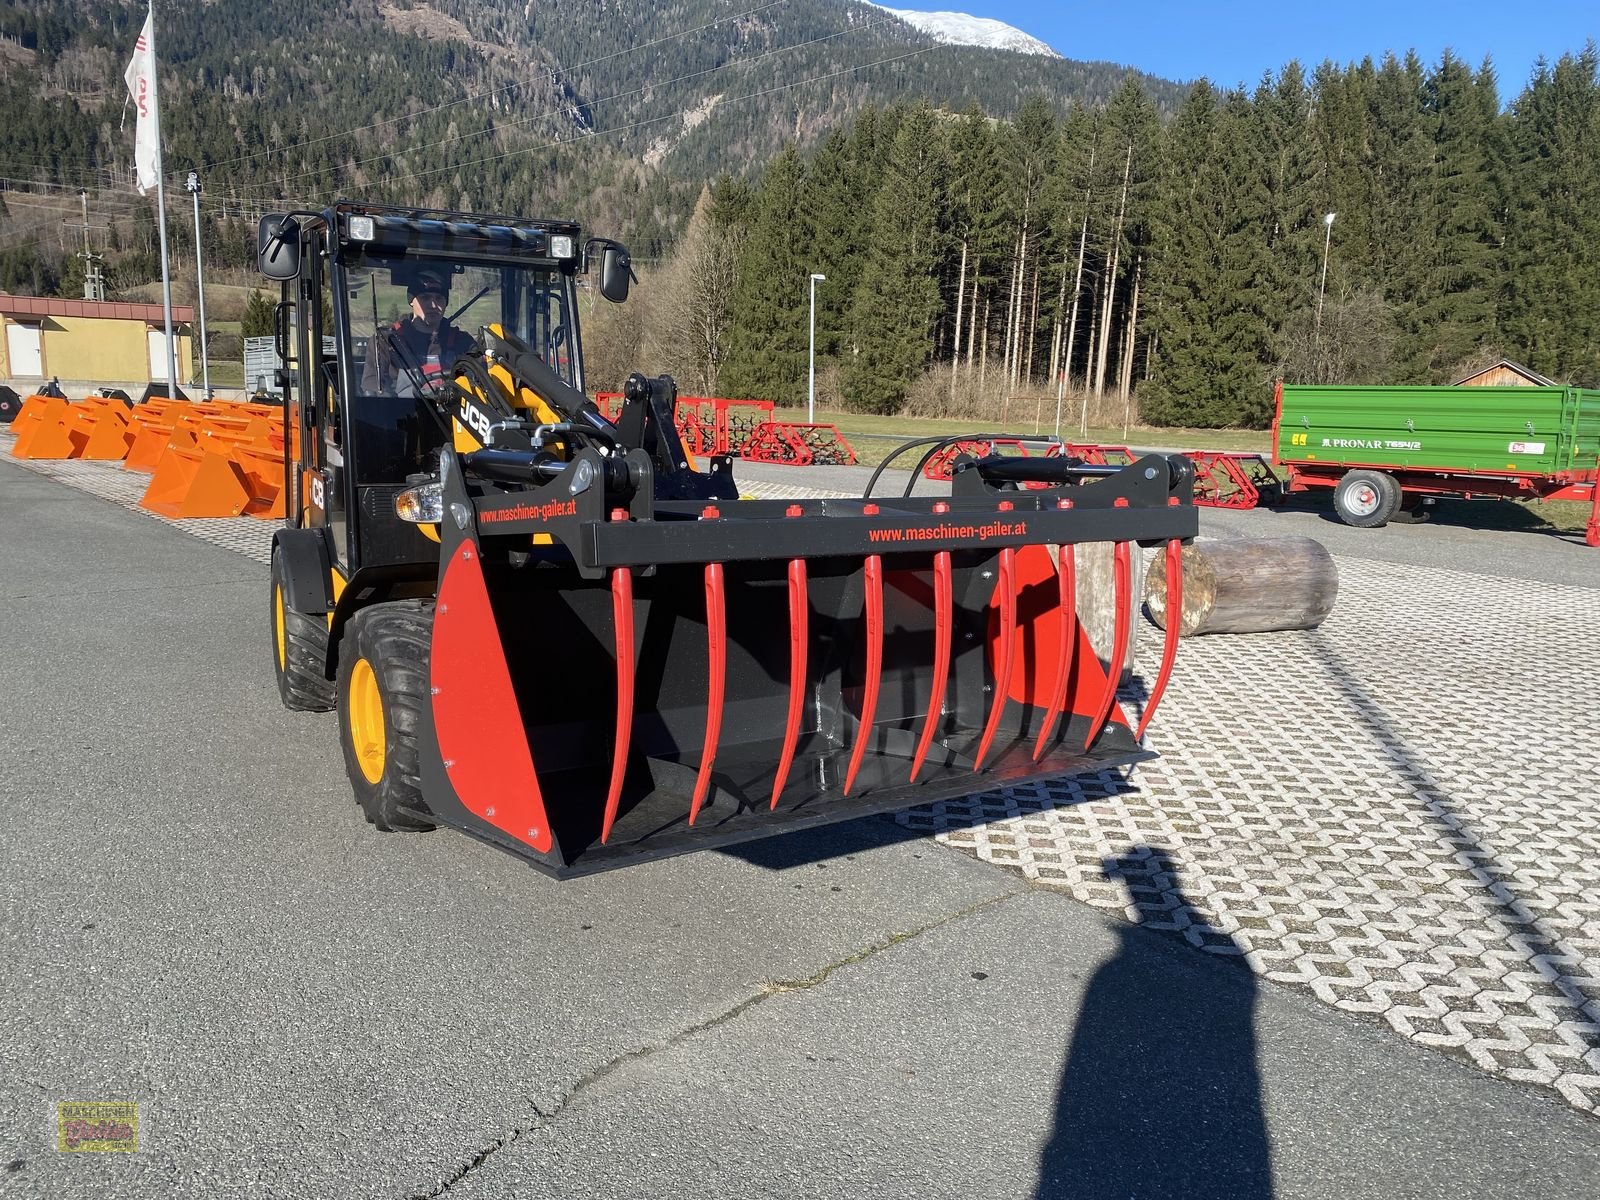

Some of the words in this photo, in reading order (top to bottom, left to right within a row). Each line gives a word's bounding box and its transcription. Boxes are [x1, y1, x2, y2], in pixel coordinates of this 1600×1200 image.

[460, 396, 490, 437] JCB
[1333, 438, 1383, 449] PRONAR
[1384, 440, 1422, 450] T654/2
[309, 474, 324, 510] CB
[480, 498, 577, 523] www.maschinen-gailer.at
[868, 521, 1027, 542] www.maschinen-gailer.at
